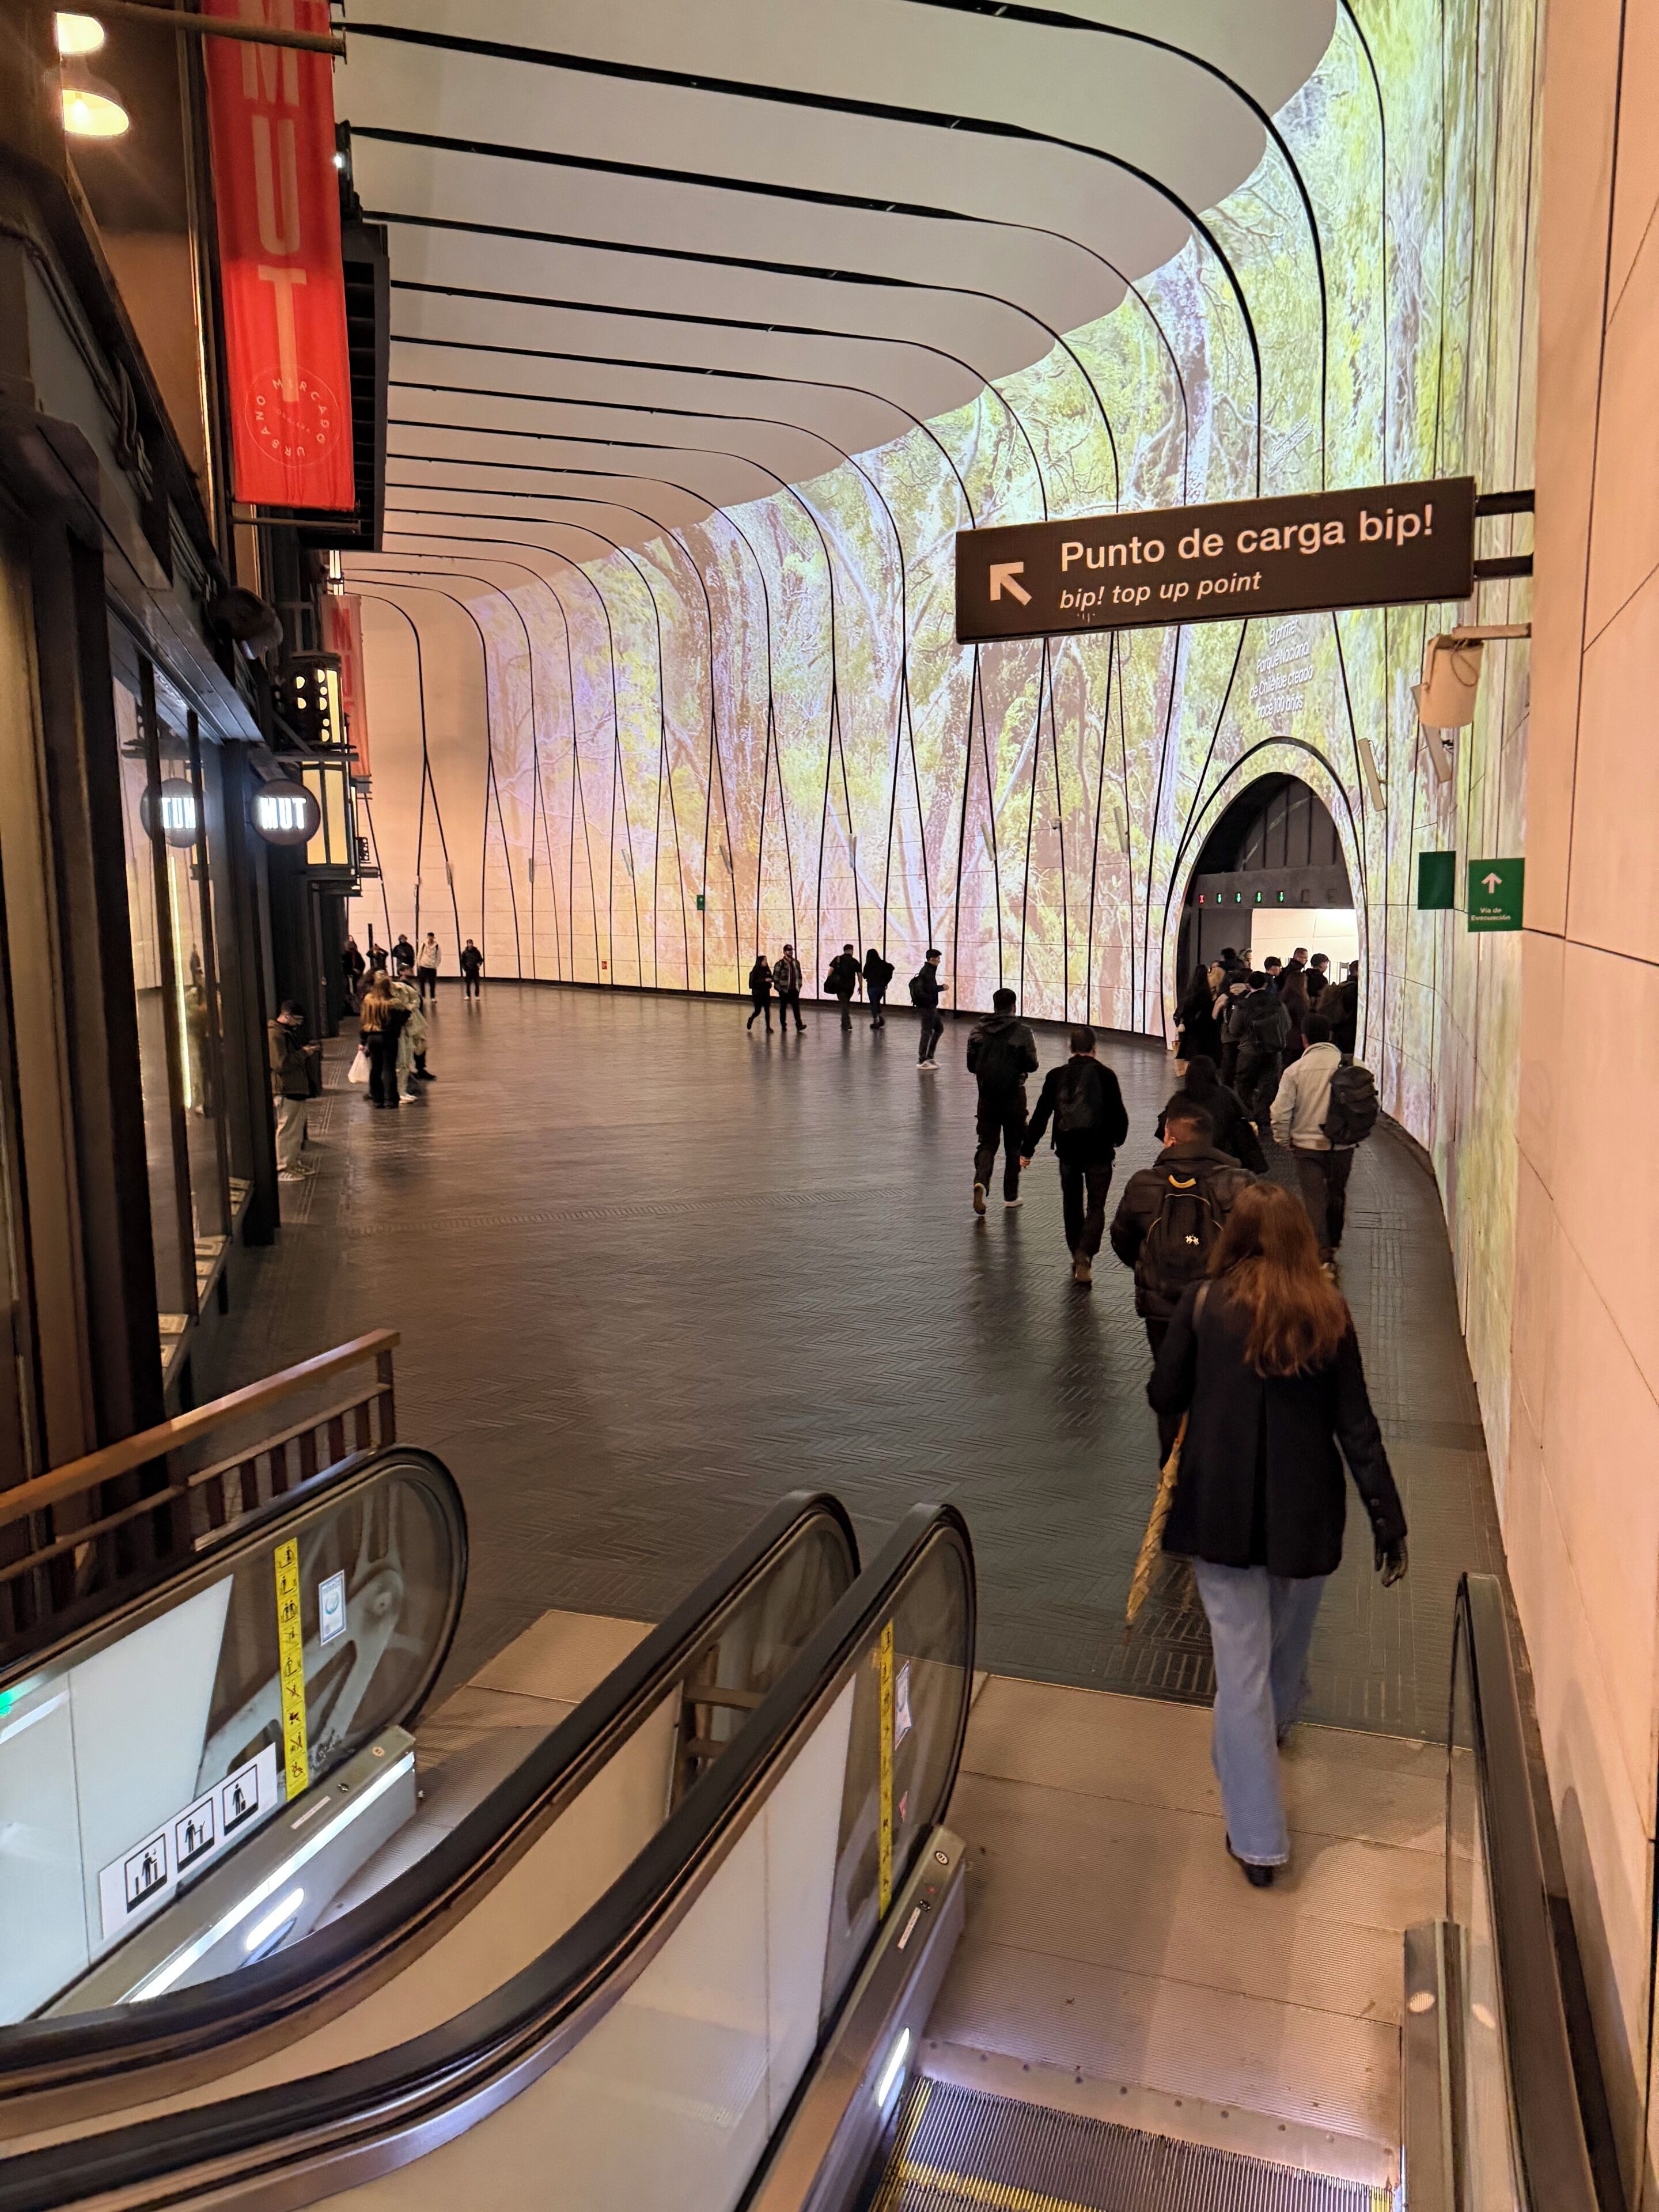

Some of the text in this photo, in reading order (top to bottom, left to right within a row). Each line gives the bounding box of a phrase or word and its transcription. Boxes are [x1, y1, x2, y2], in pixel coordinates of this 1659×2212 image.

[237, 0, 307, 402] MUT
[255, 395, 305, 457] URBANO
[1061, 504, 1434, 572] Punto de carga bip!
[1060, 571, 1262, 611] bip! top up point
[1256, 641, 1310, 675] Parque Nacional
[1287, 664, 1314, 686] creado
[260, 797, 306, 830] MUT
